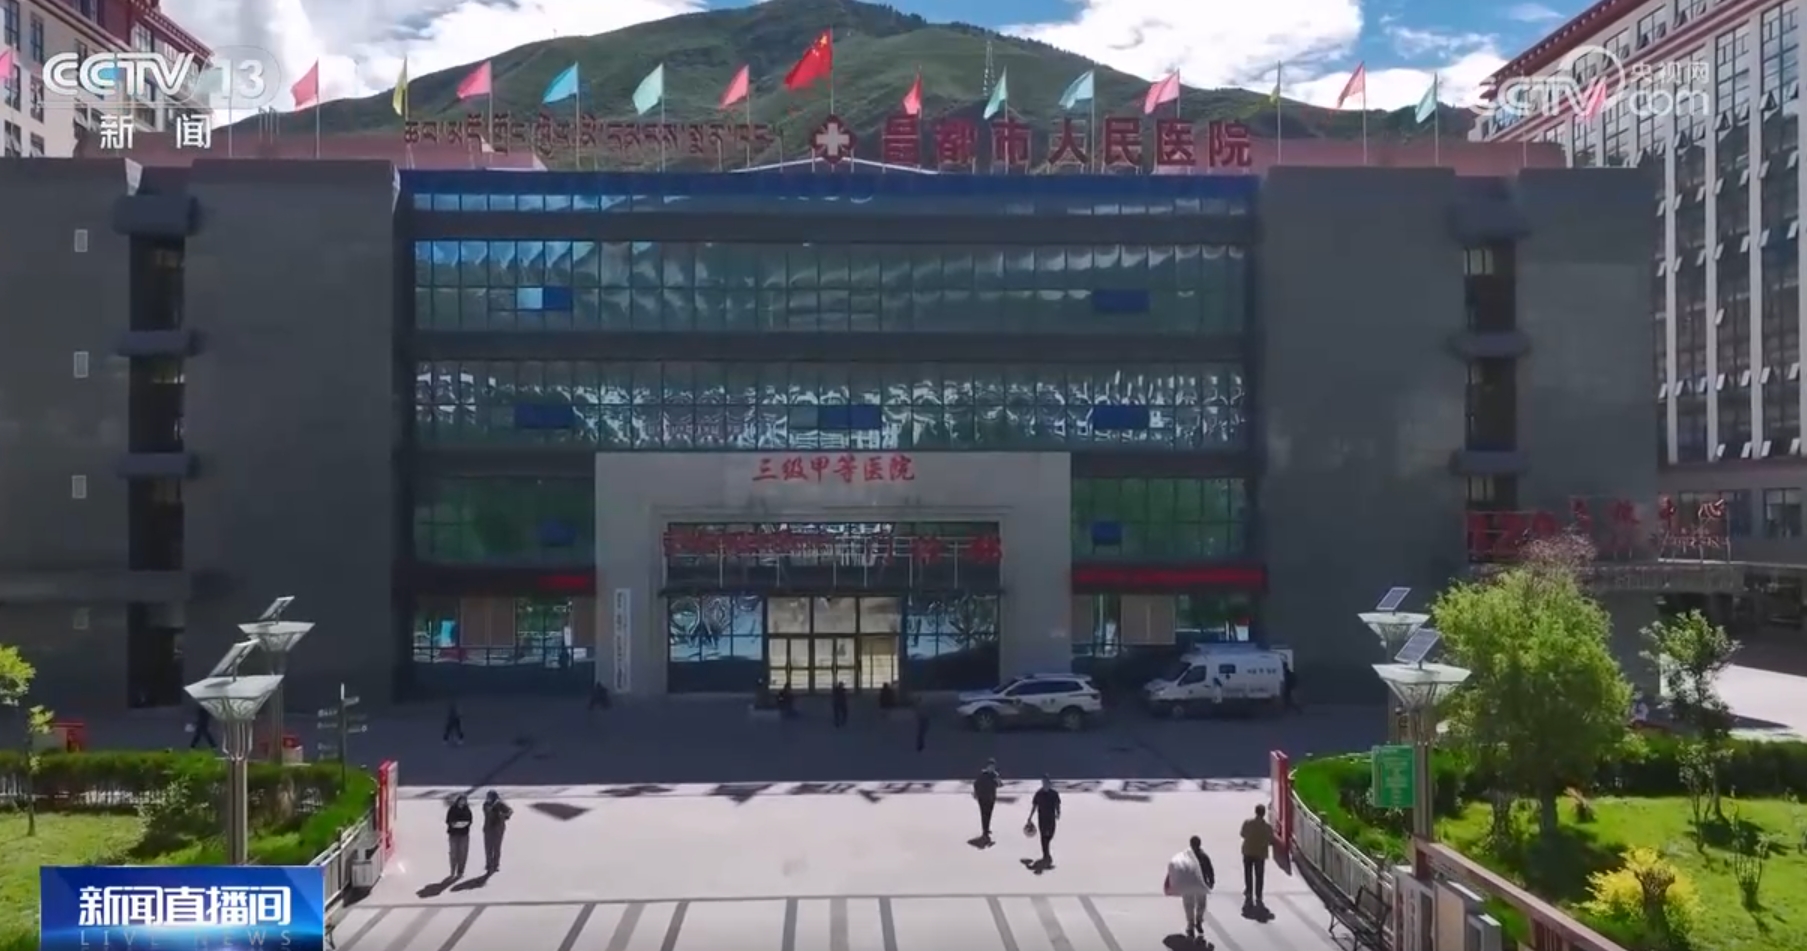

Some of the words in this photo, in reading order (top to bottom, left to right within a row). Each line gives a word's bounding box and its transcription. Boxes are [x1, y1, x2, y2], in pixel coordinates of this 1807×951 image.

[882, 114, 1253, 168] 昌都市人民医院
[752, 454, 916, 483] 三级甲等医院
